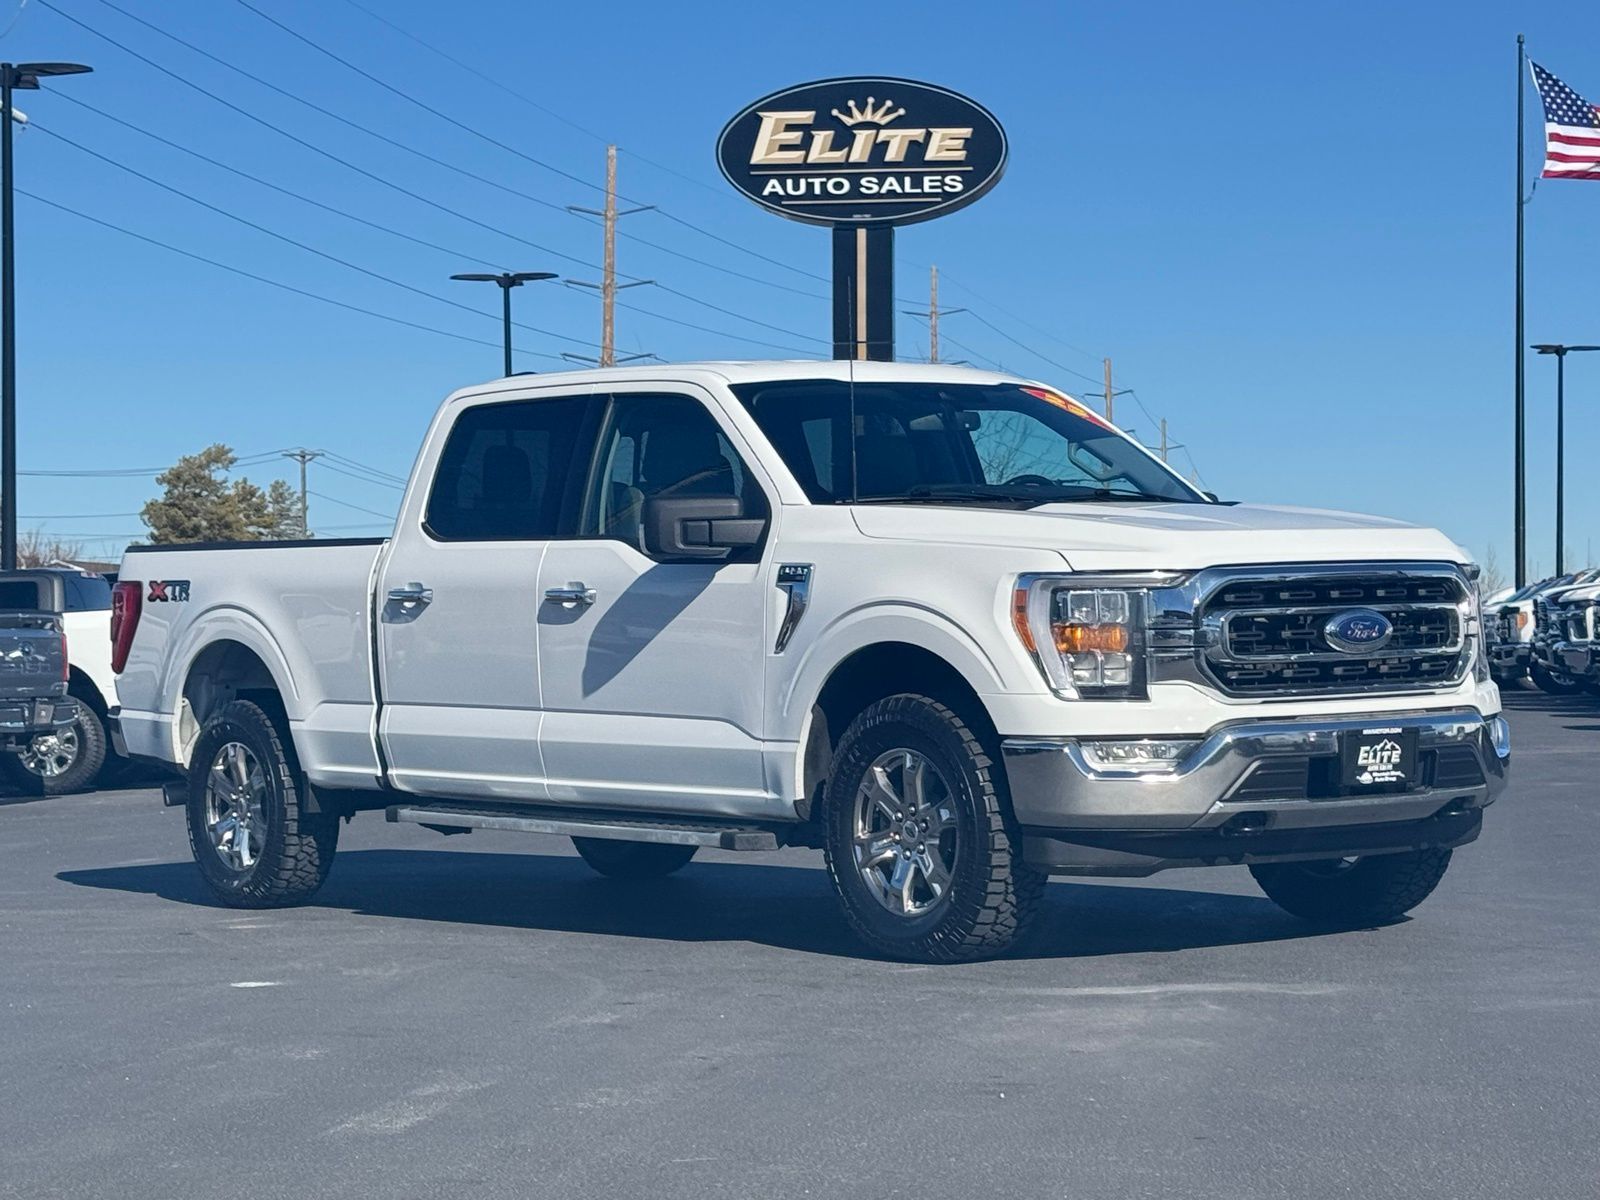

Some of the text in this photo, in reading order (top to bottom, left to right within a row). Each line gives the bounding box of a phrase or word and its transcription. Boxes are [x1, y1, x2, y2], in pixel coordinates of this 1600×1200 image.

[749, 110, 974, 165] ELITE
[762, 175, 964, 196] AUTO SALES
[1347, 621, 1379, 639] Ford
[1358, 746, 1401, 765] ELITE
